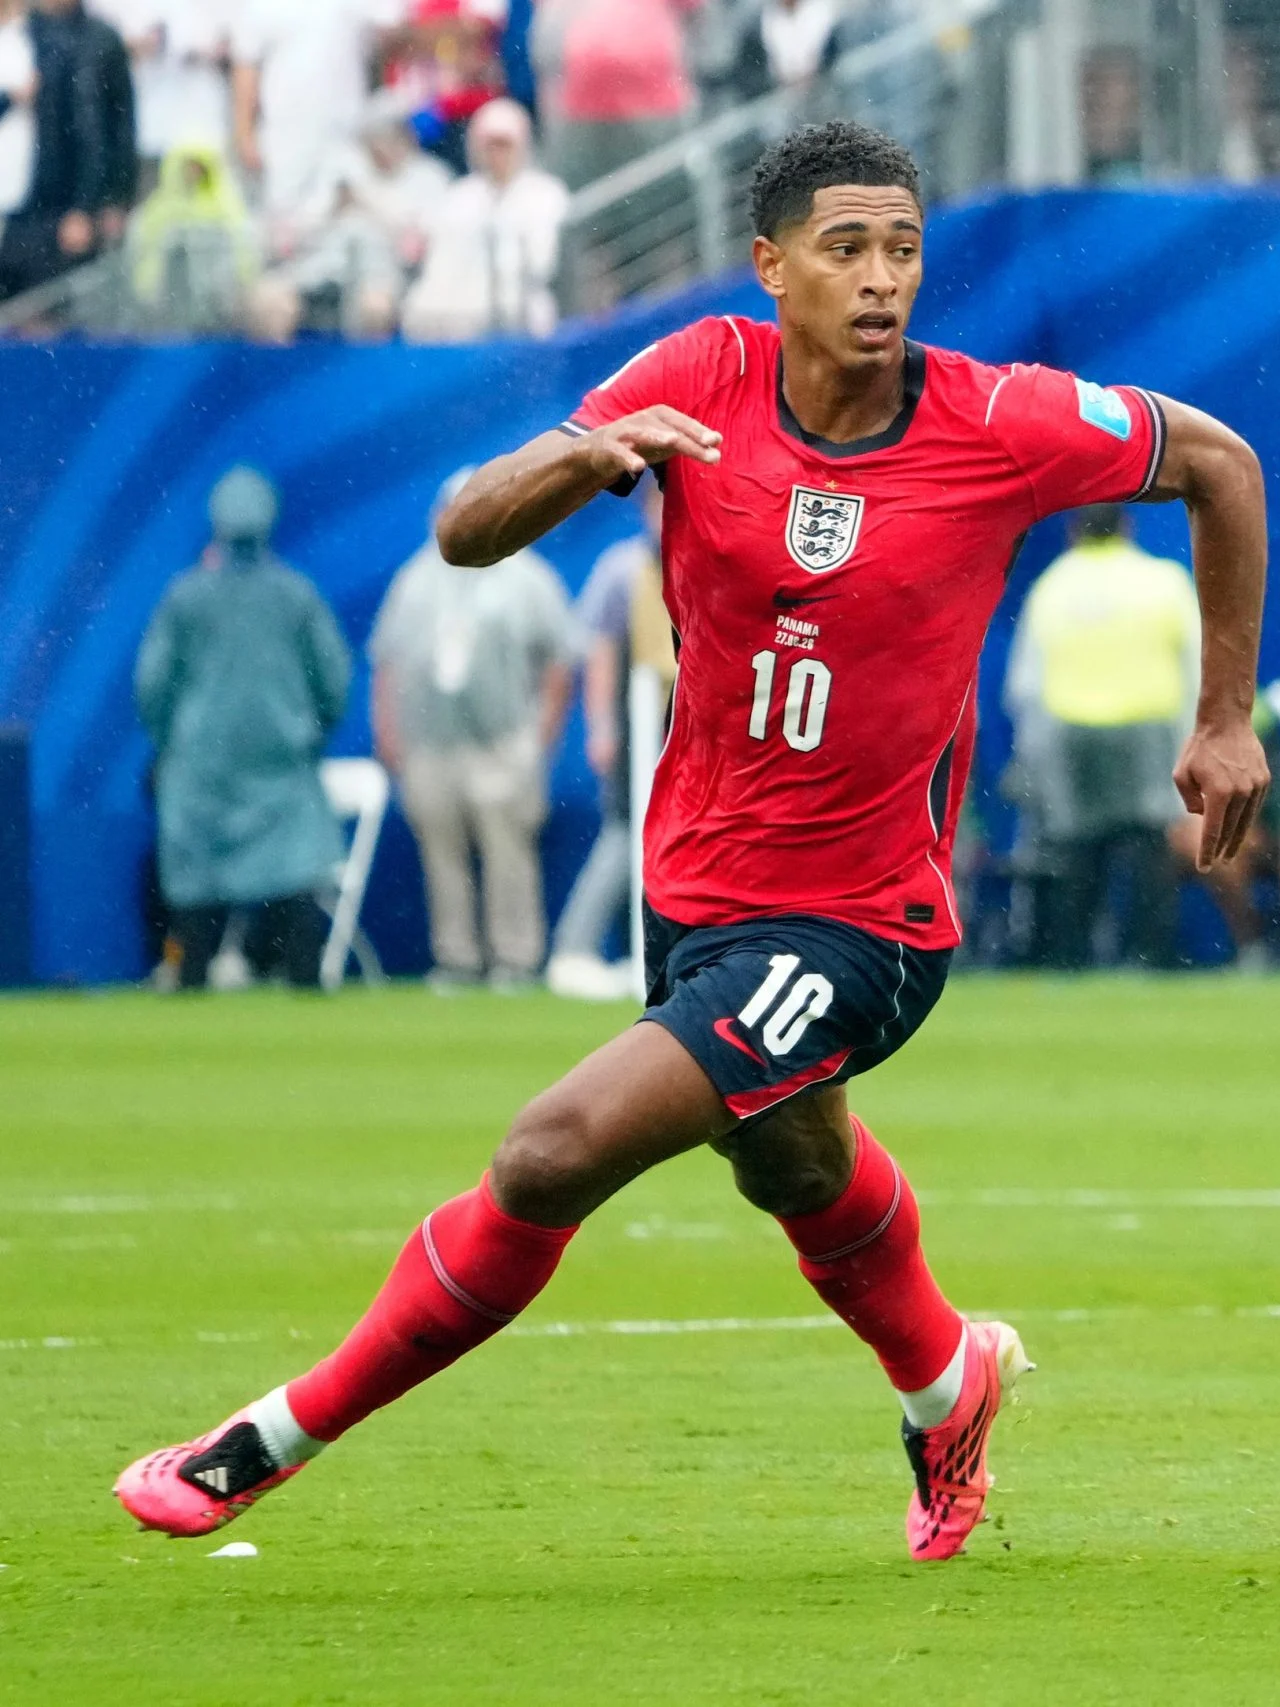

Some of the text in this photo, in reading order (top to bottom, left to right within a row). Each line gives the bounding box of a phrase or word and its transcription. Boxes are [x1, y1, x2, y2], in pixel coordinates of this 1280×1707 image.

[776, 615, 819, 636] PANAMA
[748, 649, 832, 752] 10
[738, 953, 834, 1056] 10
